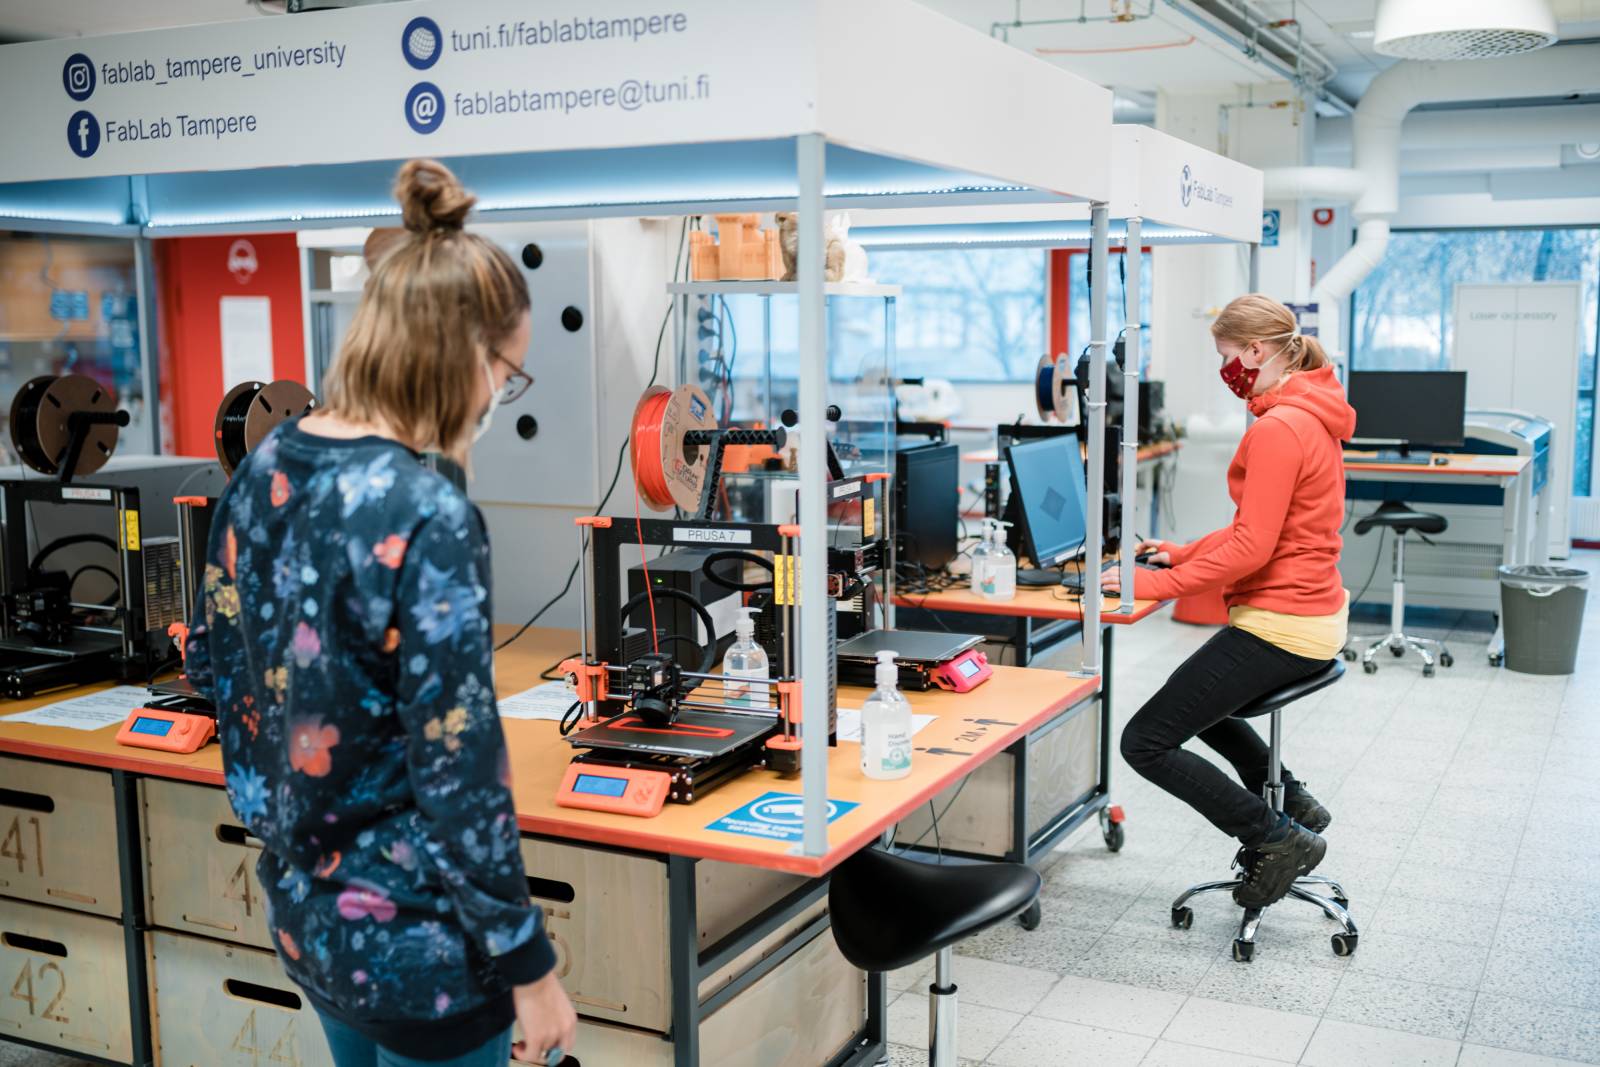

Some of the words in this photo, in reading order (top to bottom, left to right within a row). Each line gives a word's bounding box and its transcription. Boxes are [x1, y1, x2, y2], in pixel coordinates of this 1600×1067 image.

[451, 12, 688, 52] tuni.fi/fablabtampere
[101, 41, 346, 86] fablab_tampere_university
[454, 74, 711, 117] fablabtampere@tuni.fi
[105, 117, 172, 143] FabLab
[176, 114, 257, 140] Tampere
[688, 529, 727, 542] PRUSA
[729, 531, 736, 542] 7
[0, 814, 44, 877] 41
[223, 854, 259, 918] 4
[10, 957, 70, 1024] 42
